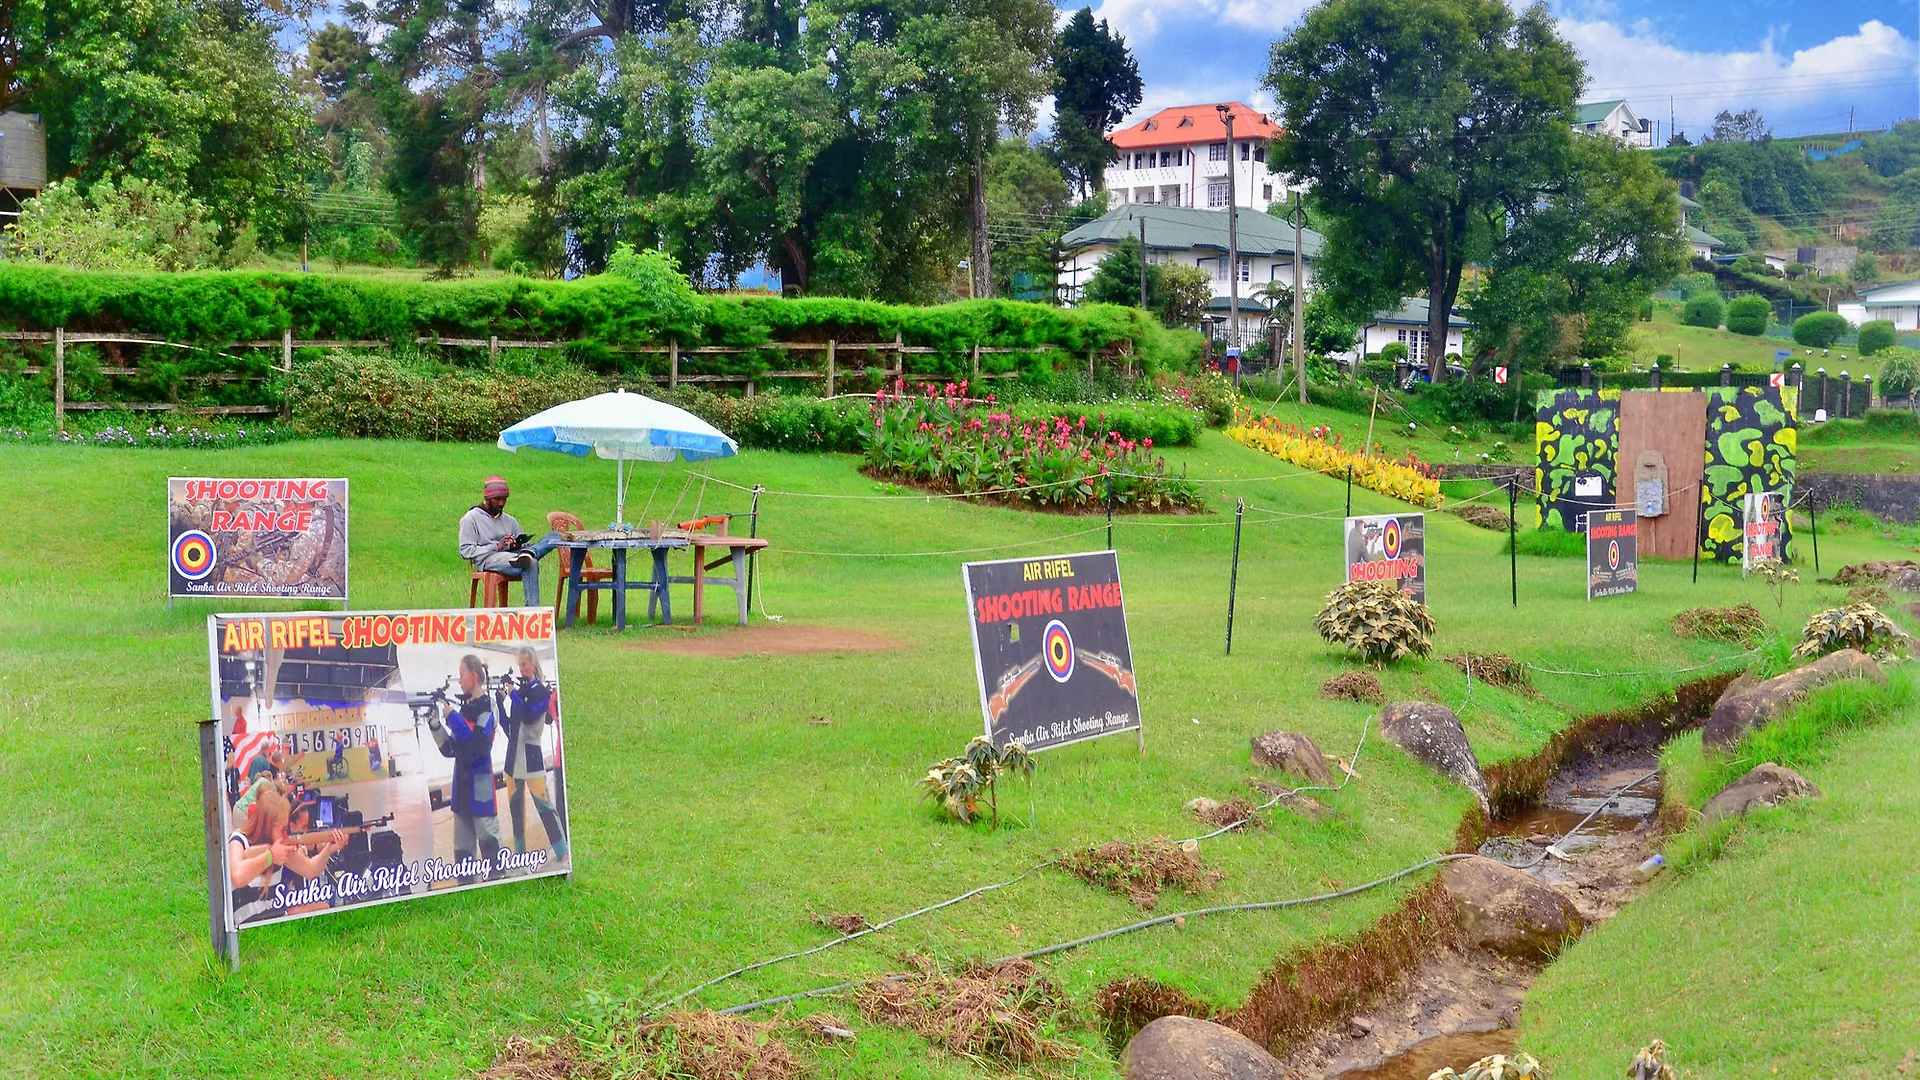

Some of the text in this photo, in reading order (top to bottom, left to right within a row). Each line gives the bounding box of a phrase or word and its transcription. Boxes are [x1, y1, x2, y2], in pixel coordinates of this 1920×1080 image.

[184, 480, 328, 500] SHOOTING
[211, 511, 313, 532] RANGE
[1023, 559, 1075, 581] AIR RIFEL
[1350, 557, 1418, 583] SHOOTING
[186, 581, 331, 595] Sanka Air Rifel Shooting Range
[977, 582, 1122, 624] SHOOTING RANGE
[223, 612, 553, 652] AIR RIFEL SHOOTING RANGE
[1036, 725, 1049, 742] Air
[1051, 720, 1071, 741] Rifel
[1073, 715, 1104, 734] Shooting
[1105, 711, 1129, 728] Range
[272, 847, 547, 910] Sanka Air Rifel Shooting Range
